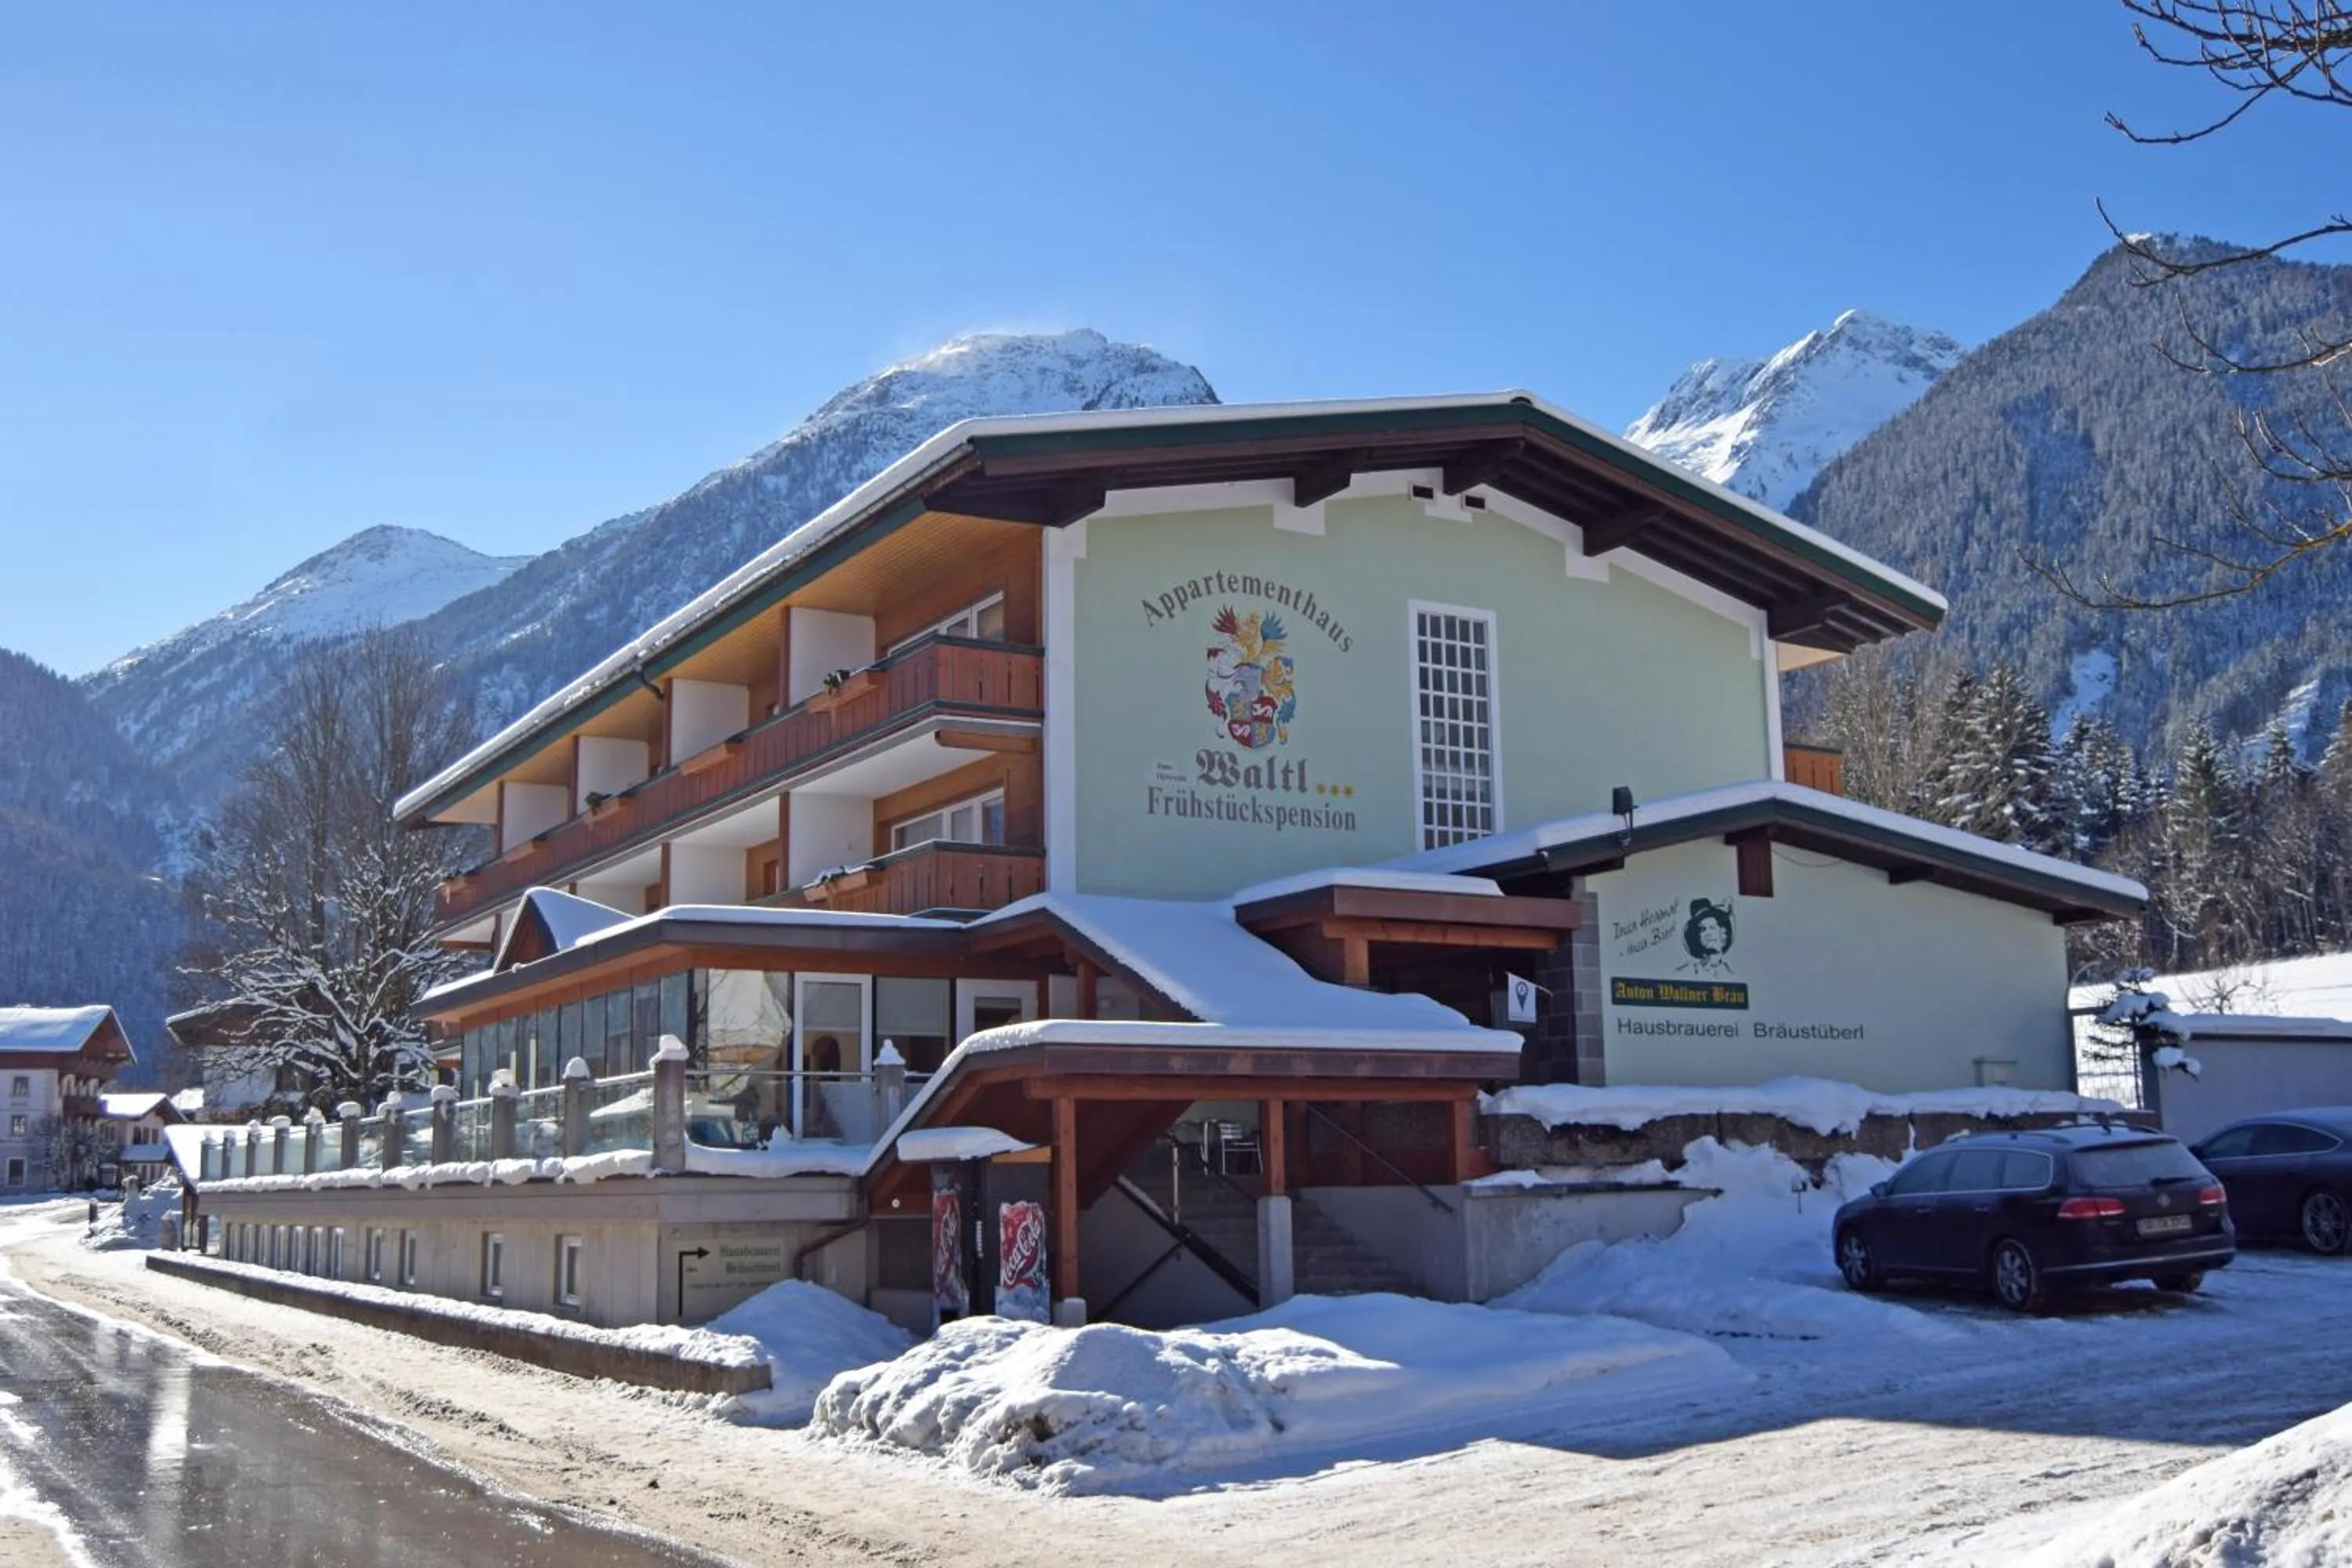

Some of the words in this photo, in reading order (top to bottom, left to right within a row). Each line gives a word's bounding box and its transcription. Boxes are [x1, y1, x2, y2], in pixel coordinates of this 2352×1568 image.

[1141, 569, 1355, 653] Appartementhaus
[1196, 749, 1308, 794] Waltl
[1147, 786, 1356, 832] Frühstückspension
[1616, 982, 1654, 1000] Anton
[1617, 1019, 1739, 1037] Hausbrauerei
[1753, 1022, 1864, 1040] Bräustüberl
